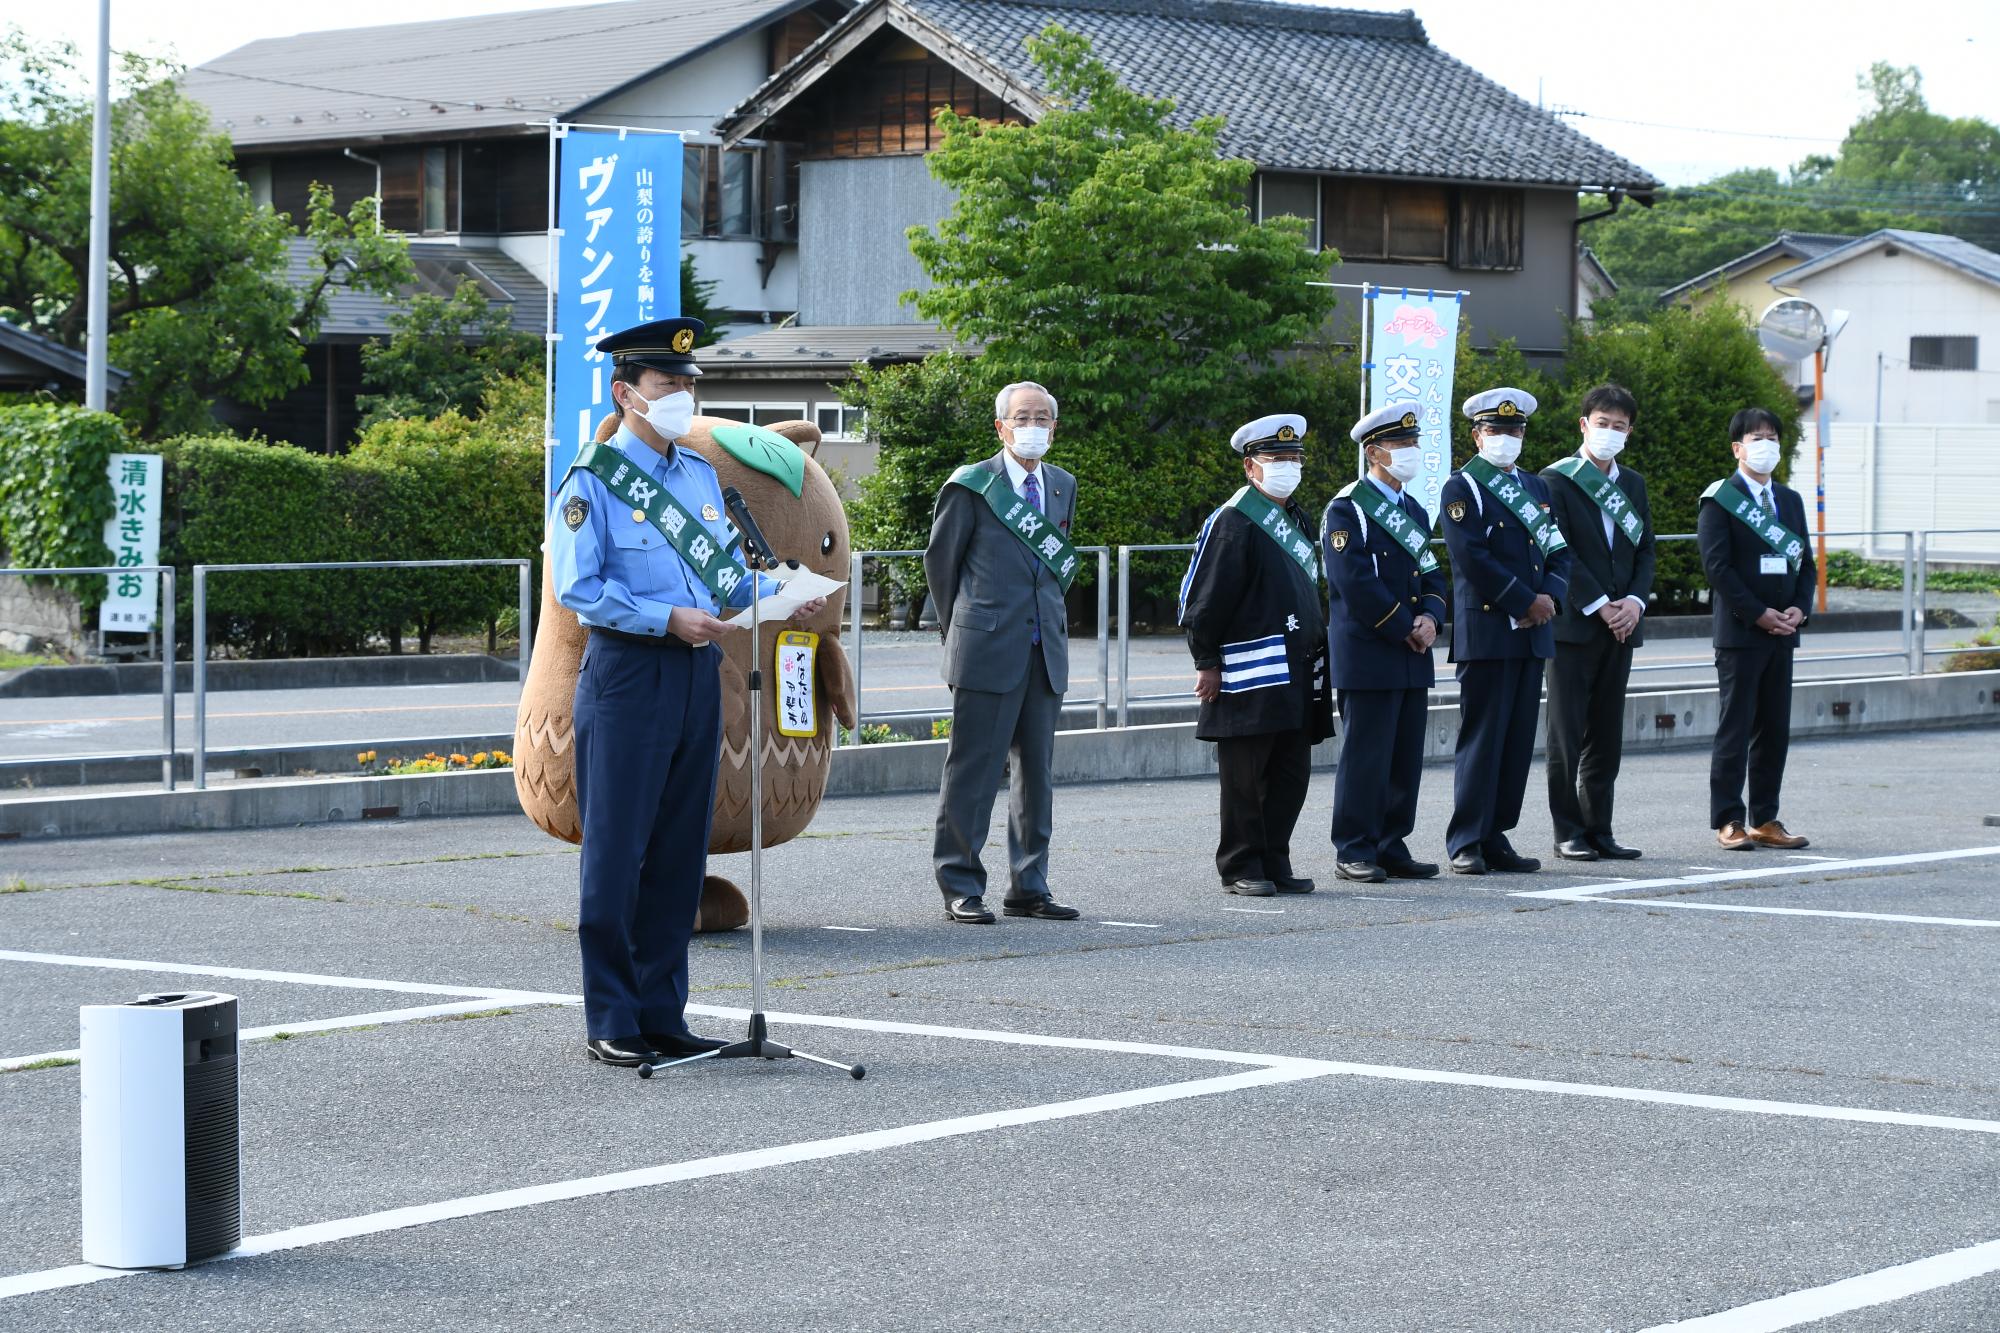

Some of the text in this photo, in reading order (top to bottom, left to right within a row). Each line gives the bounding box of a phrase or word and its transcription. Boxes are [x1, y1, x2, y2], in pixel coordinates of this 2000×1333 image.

[578, 153, 619, 448] ヴァンフォー
[636, 168, 654, 321] 山梨の誇りを胸に
[1385, 354, 1421, 406] 交
[1423, 359, 1444, 518] みんなで守ろう
[117, 460, 147, 598] 清水きみお
[610, 463, 630, 487] 甲斐市
[627, 476, 742, 597] 交通安全
